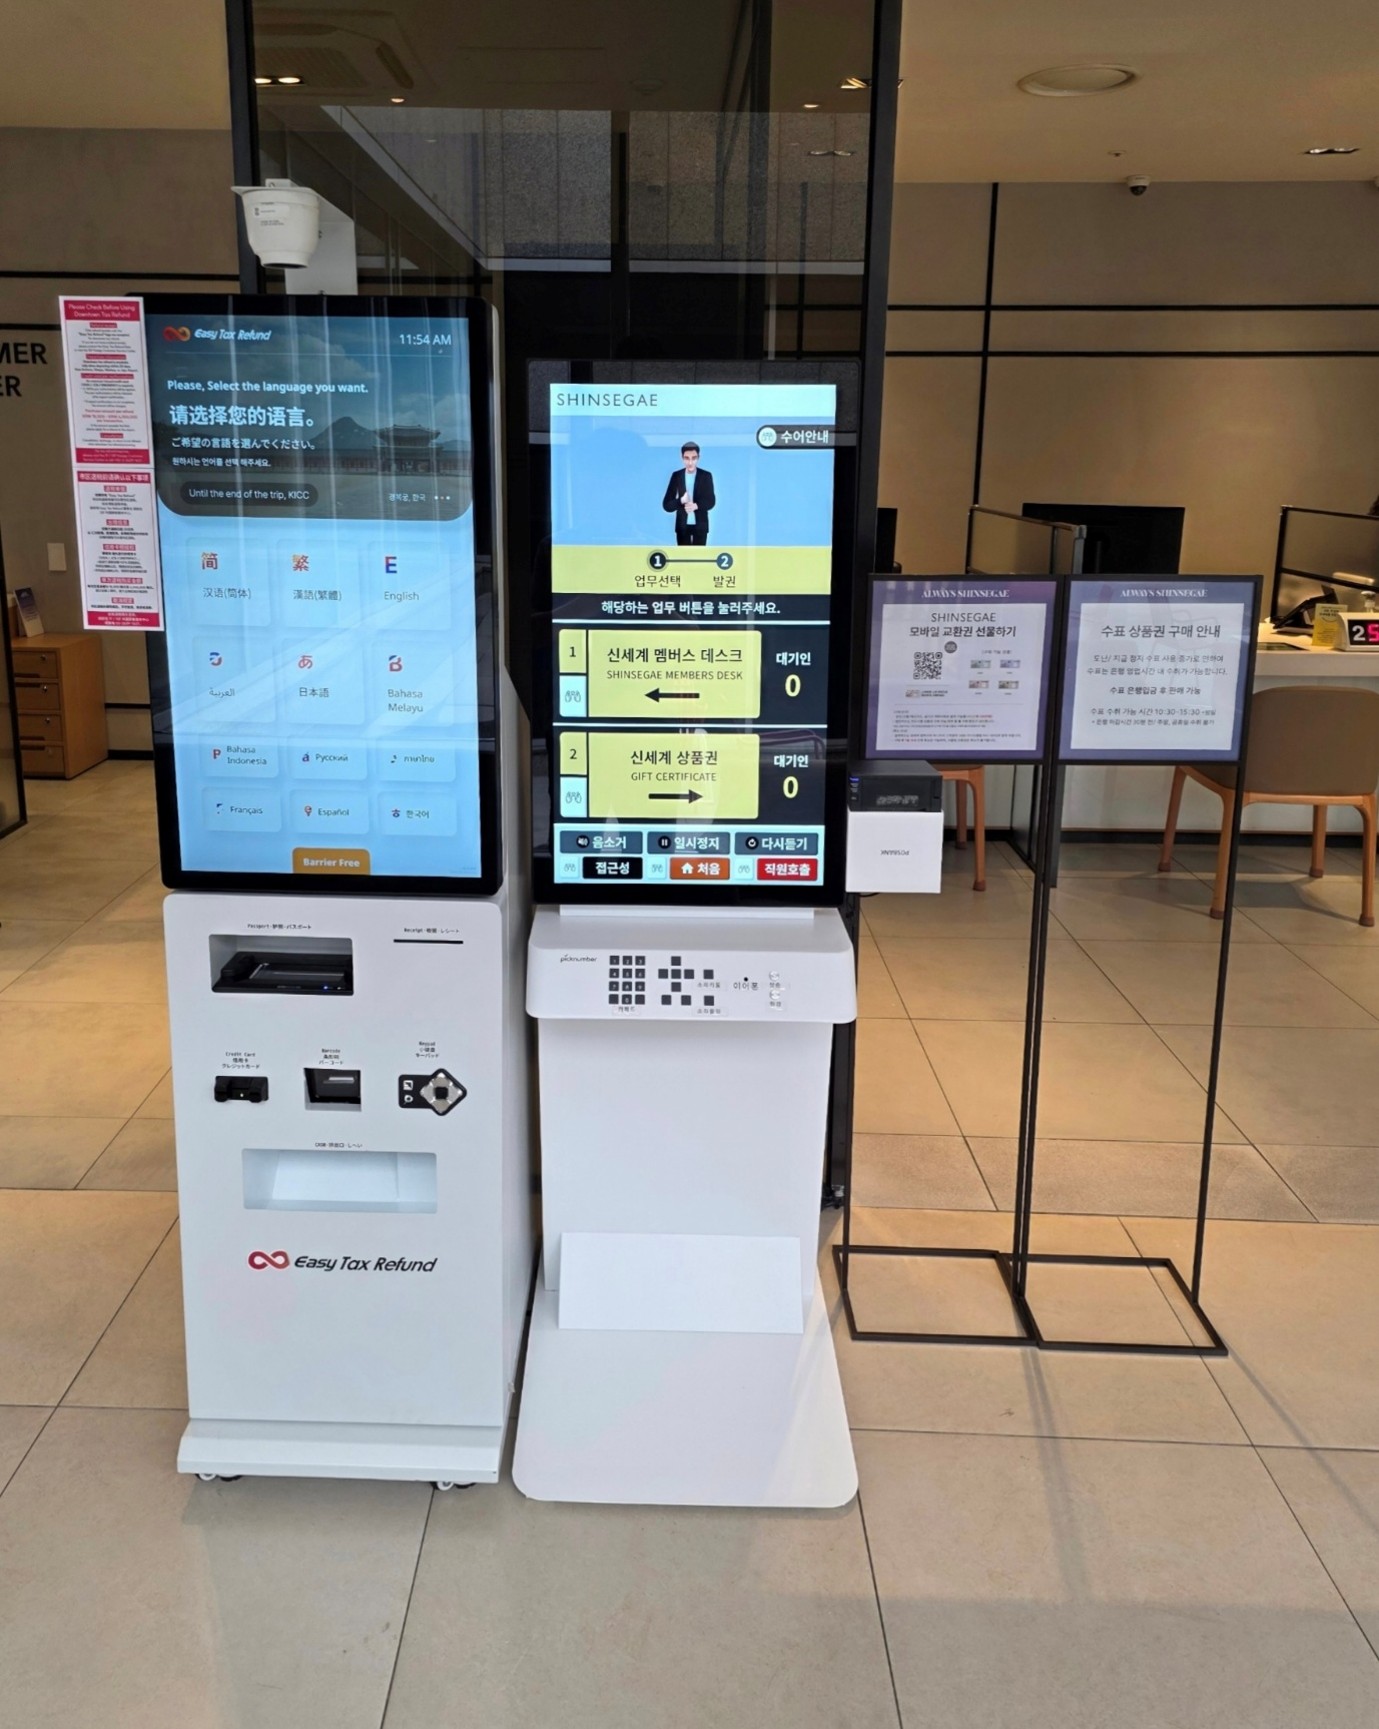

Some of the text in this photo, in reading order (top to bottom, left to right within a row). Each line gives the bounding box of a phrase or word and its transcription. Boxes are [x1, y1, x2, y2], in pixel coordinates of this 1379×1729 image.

[194, 329, 271, 341] Easy Tax Refund
[399, 334, 451, 345] 11:54 AM
[167, 380, 369, 395] Please, Select the language you want.
[556, 393, 658, 407] SHINSEGAE
[169, 405, 314, 427] 请选择您的语言。
[780, 430, 830, 444] 수어안내
[172, 437, 316, 450] ご希望の言語を選んでください。
[172, 457, 200, 466] 원하시는
[202, 458, 223, 467] 언어를
[225, 458, 240, 467] 선택
[188, 488, 310, 500] Until the end of the trip, KICC
[412, 494, 426, 502] 한국
[201, 552, 219, 570] 简
[291, 554, 310, 572] 繁
[385, 556, 398, 574] E
[654, 555, 662, 567] 1
[721, 555, 729, 567] 2
[634, 575, 681, 588] 업무선택
[713, 575, 736, 588] 발권
[203, 587, 252, 599] 汉语(简体)
[293, 589, 342, 601] 漢語(繁體)
[384, 591, 420, 603] English
[921, 590, 1010, 598] ALWAYS SHINSEGAE
[601, 601, 781, 615] 해당하는 업무 버튼을 눌러주세요.
[931, 612, 996, 623] SHINSEGAE
[909, 626, 1017, 638] 모바일 교환권 선물하기
[1101, 625, 1221, 638] 수표 상품권 구매 안내
[569, 646, 577, 658] 1
[607, 648, 742, 663] 신세계 멤버스 데스크
[298, 655, 313, 670] あ
[776, 652, 812, 666] 대기인
[1146, 655, 1159, 663] 수표
[607, 670, 743, 680] SHINSEGAE MEMBERS DESK
[1087, 667, 1109, 675] 수표는
[785, 674, 801, 697] 0
[1110, 686, 1125, 695] 수표
[1127, 687, 1157, 695] 은행입금
[1168, 687, 1184, 695] 판매
[1186, 687, 1201, 695] 가능
[209, 687, 235, 699] العربية
[299, 687, 330, 698] 日本語
[388, 689, 423, 698] Bahasa
[388, 703, 424, 714] Melayu
[1091, 708, 1104, 716] 수표
[1122, 708, 1136, 716] 가능
[1139, 708, 1153, 716] 시간
[227, 745, 256, 754] Bahasa
[569, 748, 578, 760] 2
[227, 757, 267, 765] Indonesia
[315, 753, 349, 763] Русский
[630, 751, 718, 766] 신세계 상품권
[774, 754, 809, 768] 대기인
[631, 772, 717, 782] GIFT CERTIFICATE
[783, 776, 799, 798] 0
[230, 805, 263, 815] Français
[318, 807, 350, 817] Español
[406, 810, 430, 819] 한국어
[592, 836, 627, 850] 음소거
[674, 837, 720, 850] 일시정지
[762, 837, 808, 851] 다시듣기
[303, 858, 360, 868] Barrier Free
[595, 861, 630, 875] 접근성
[697, 862, 721, 876] 처음
[765, 862, 811, 876] 직원호출
[733, 982, 759, 991] 이어폰
[294, 1256, 438, 1272] Easy Tax Refund
